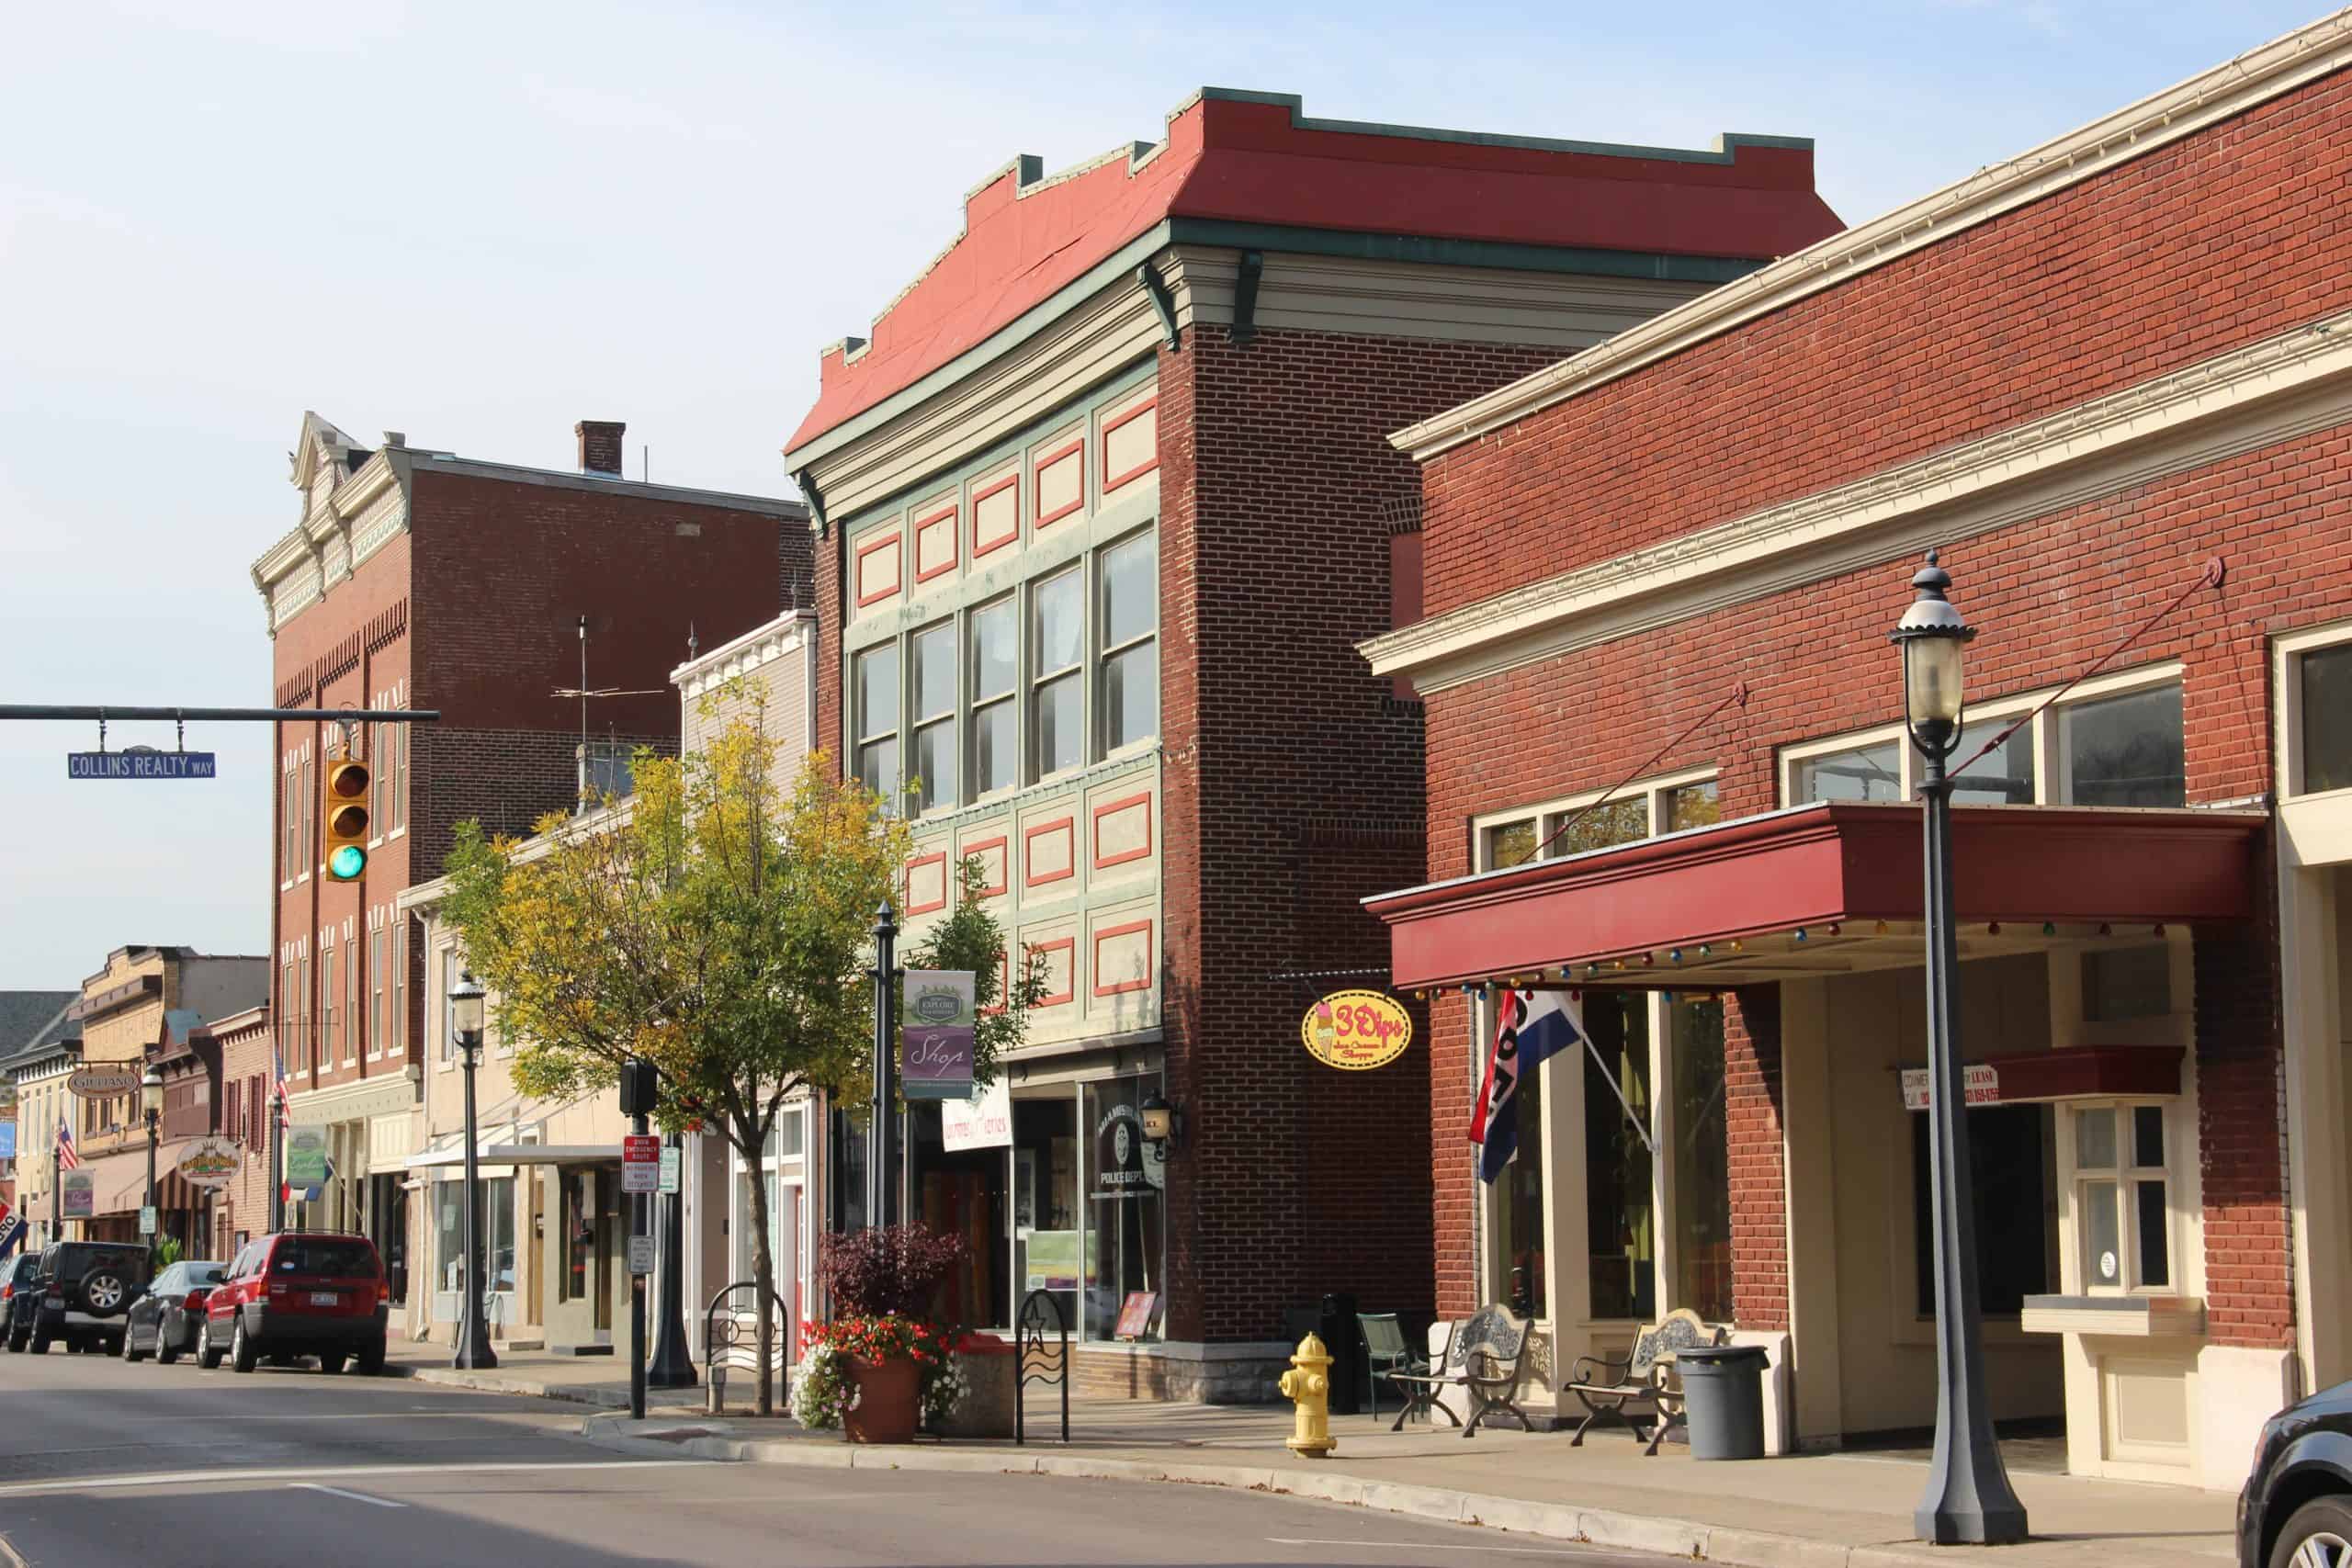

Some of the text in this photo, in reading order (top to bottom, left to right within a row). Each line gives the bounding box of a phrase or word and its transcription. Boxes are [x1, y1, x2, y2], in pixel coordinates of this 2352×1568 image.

[70, 756, 213, 776] COLLINS REALTY WAY
[1336, 1002, 1405, 1049] 3 Dips
[910, 1033, 964, 1077] Shop
[1101, 1171, 1125, 1184] POLICE
